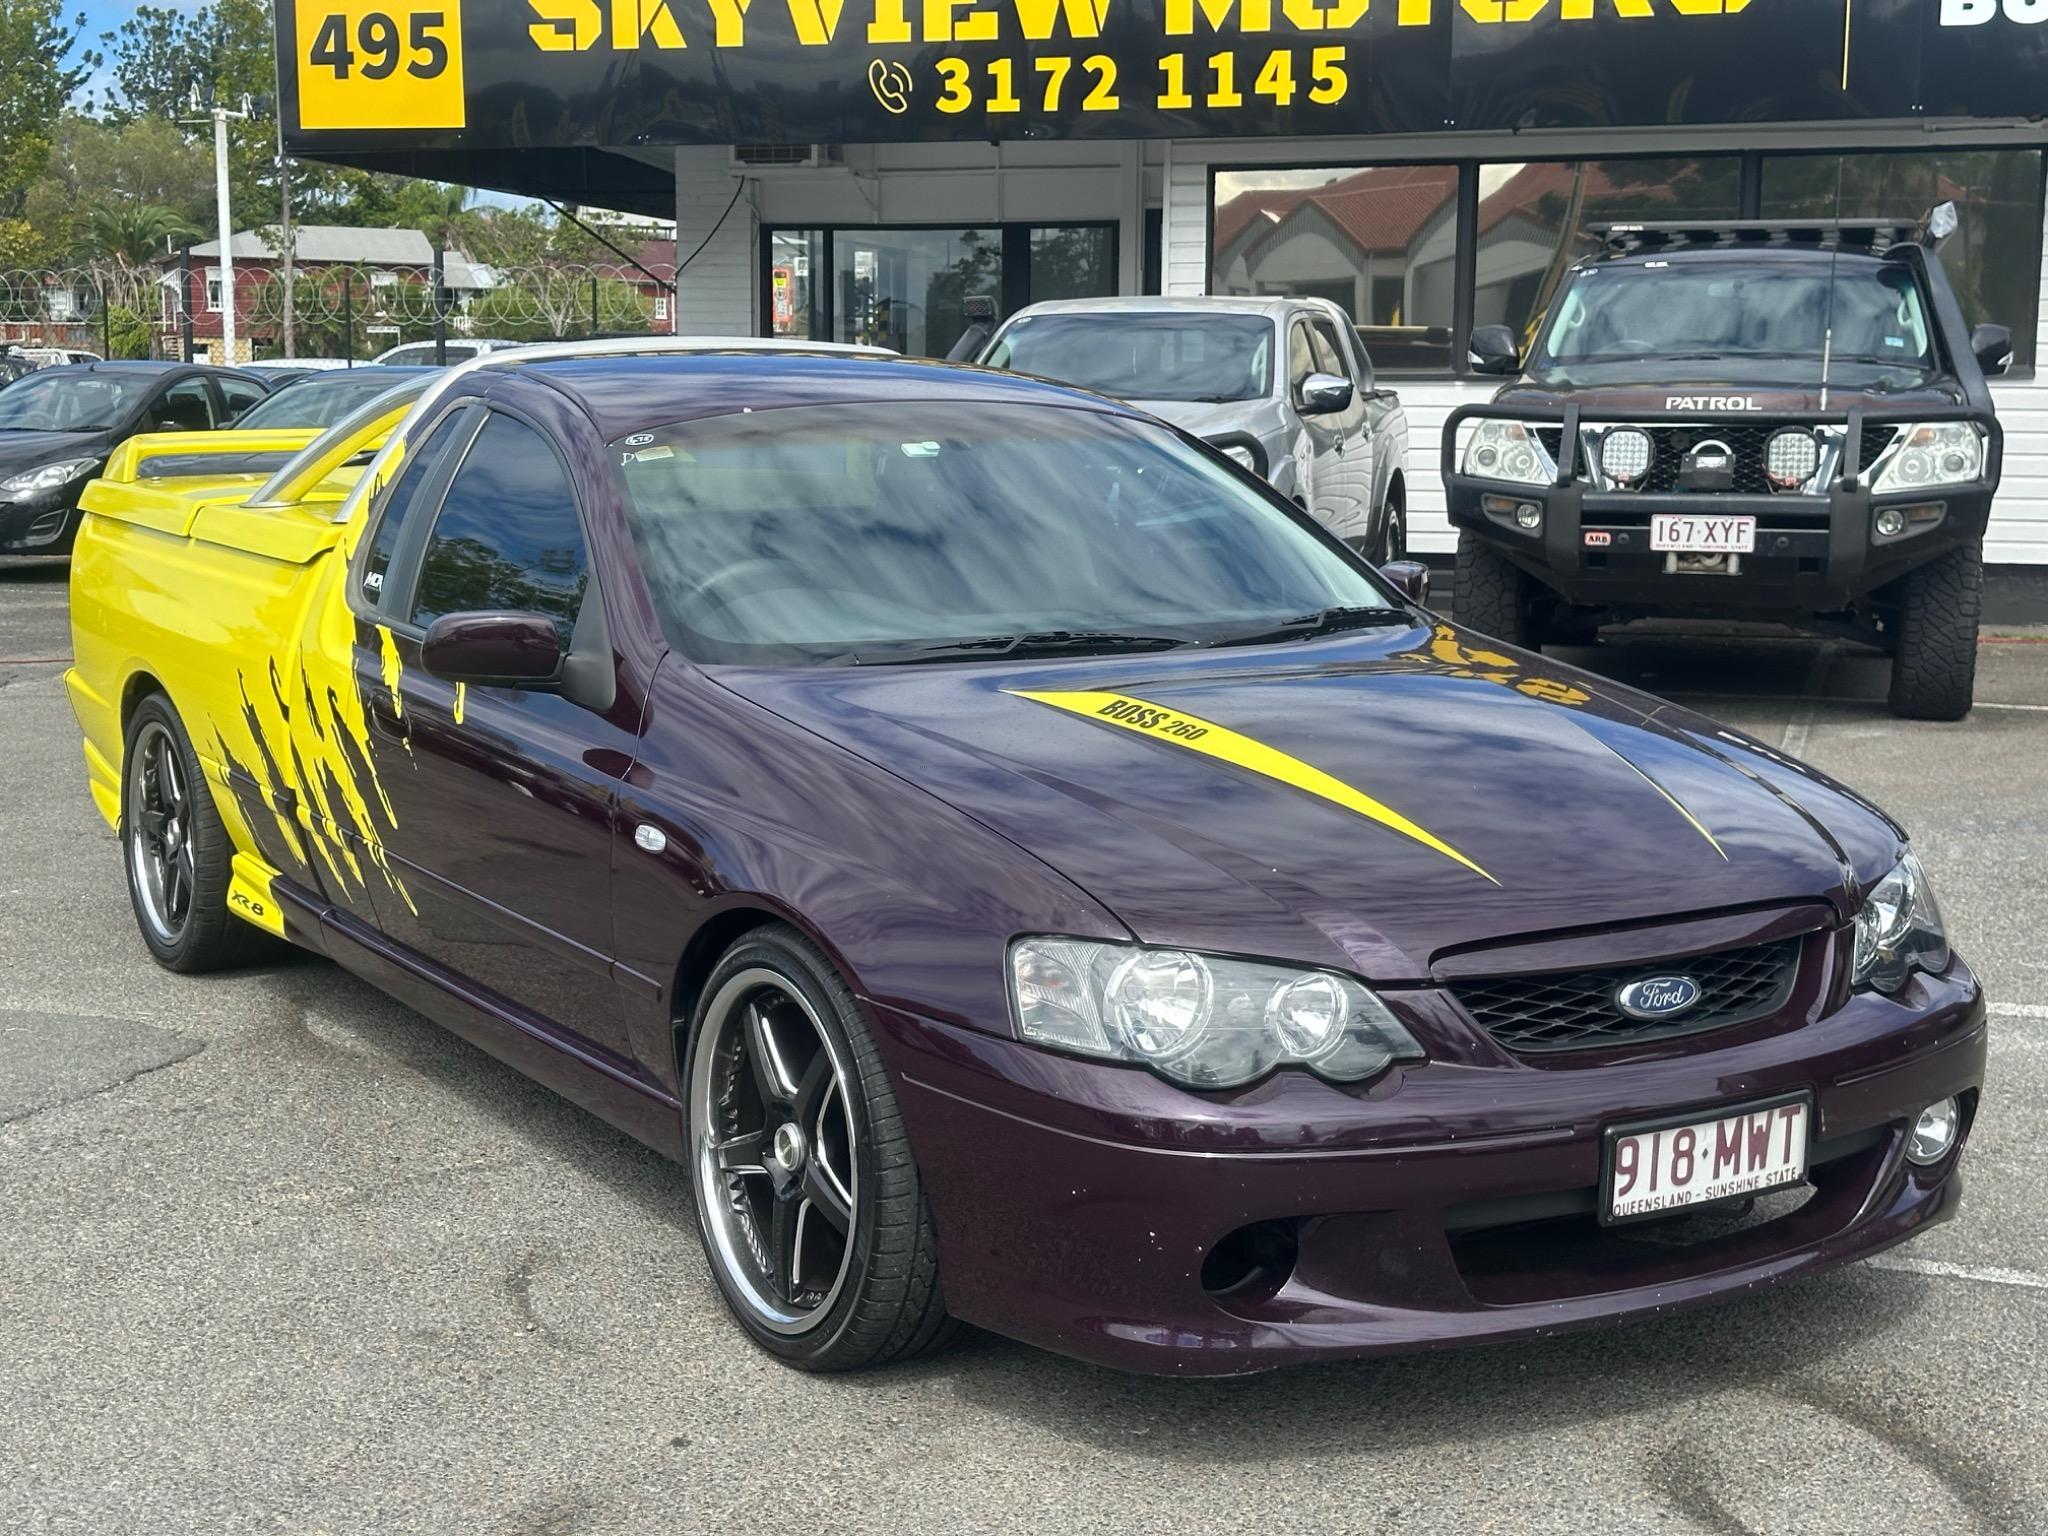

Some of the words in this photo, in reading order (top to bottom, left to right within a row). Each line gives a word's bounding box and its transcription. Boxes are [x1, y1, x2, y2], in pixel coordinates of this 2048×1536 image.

[310, 12, 448, 80] 495
[935, 55, 1120, 113] 3172
[1157, 46, 1348, 109] 1145
[1665, 396, 1763, 411] PATROL
[1096, 699, 1170, 729] BOSS
[1159, 720, 1209, 741] 260
[232, 890, 264, 916] XR8
[1640, 981, 1684, 1009] Ford
[1613, 1191, 1692, 1216] QUEENSLAND
[1705, 1176, 1760, 1200] SUNSHINE
[1765, 1167, 1797, 1186] STATE
